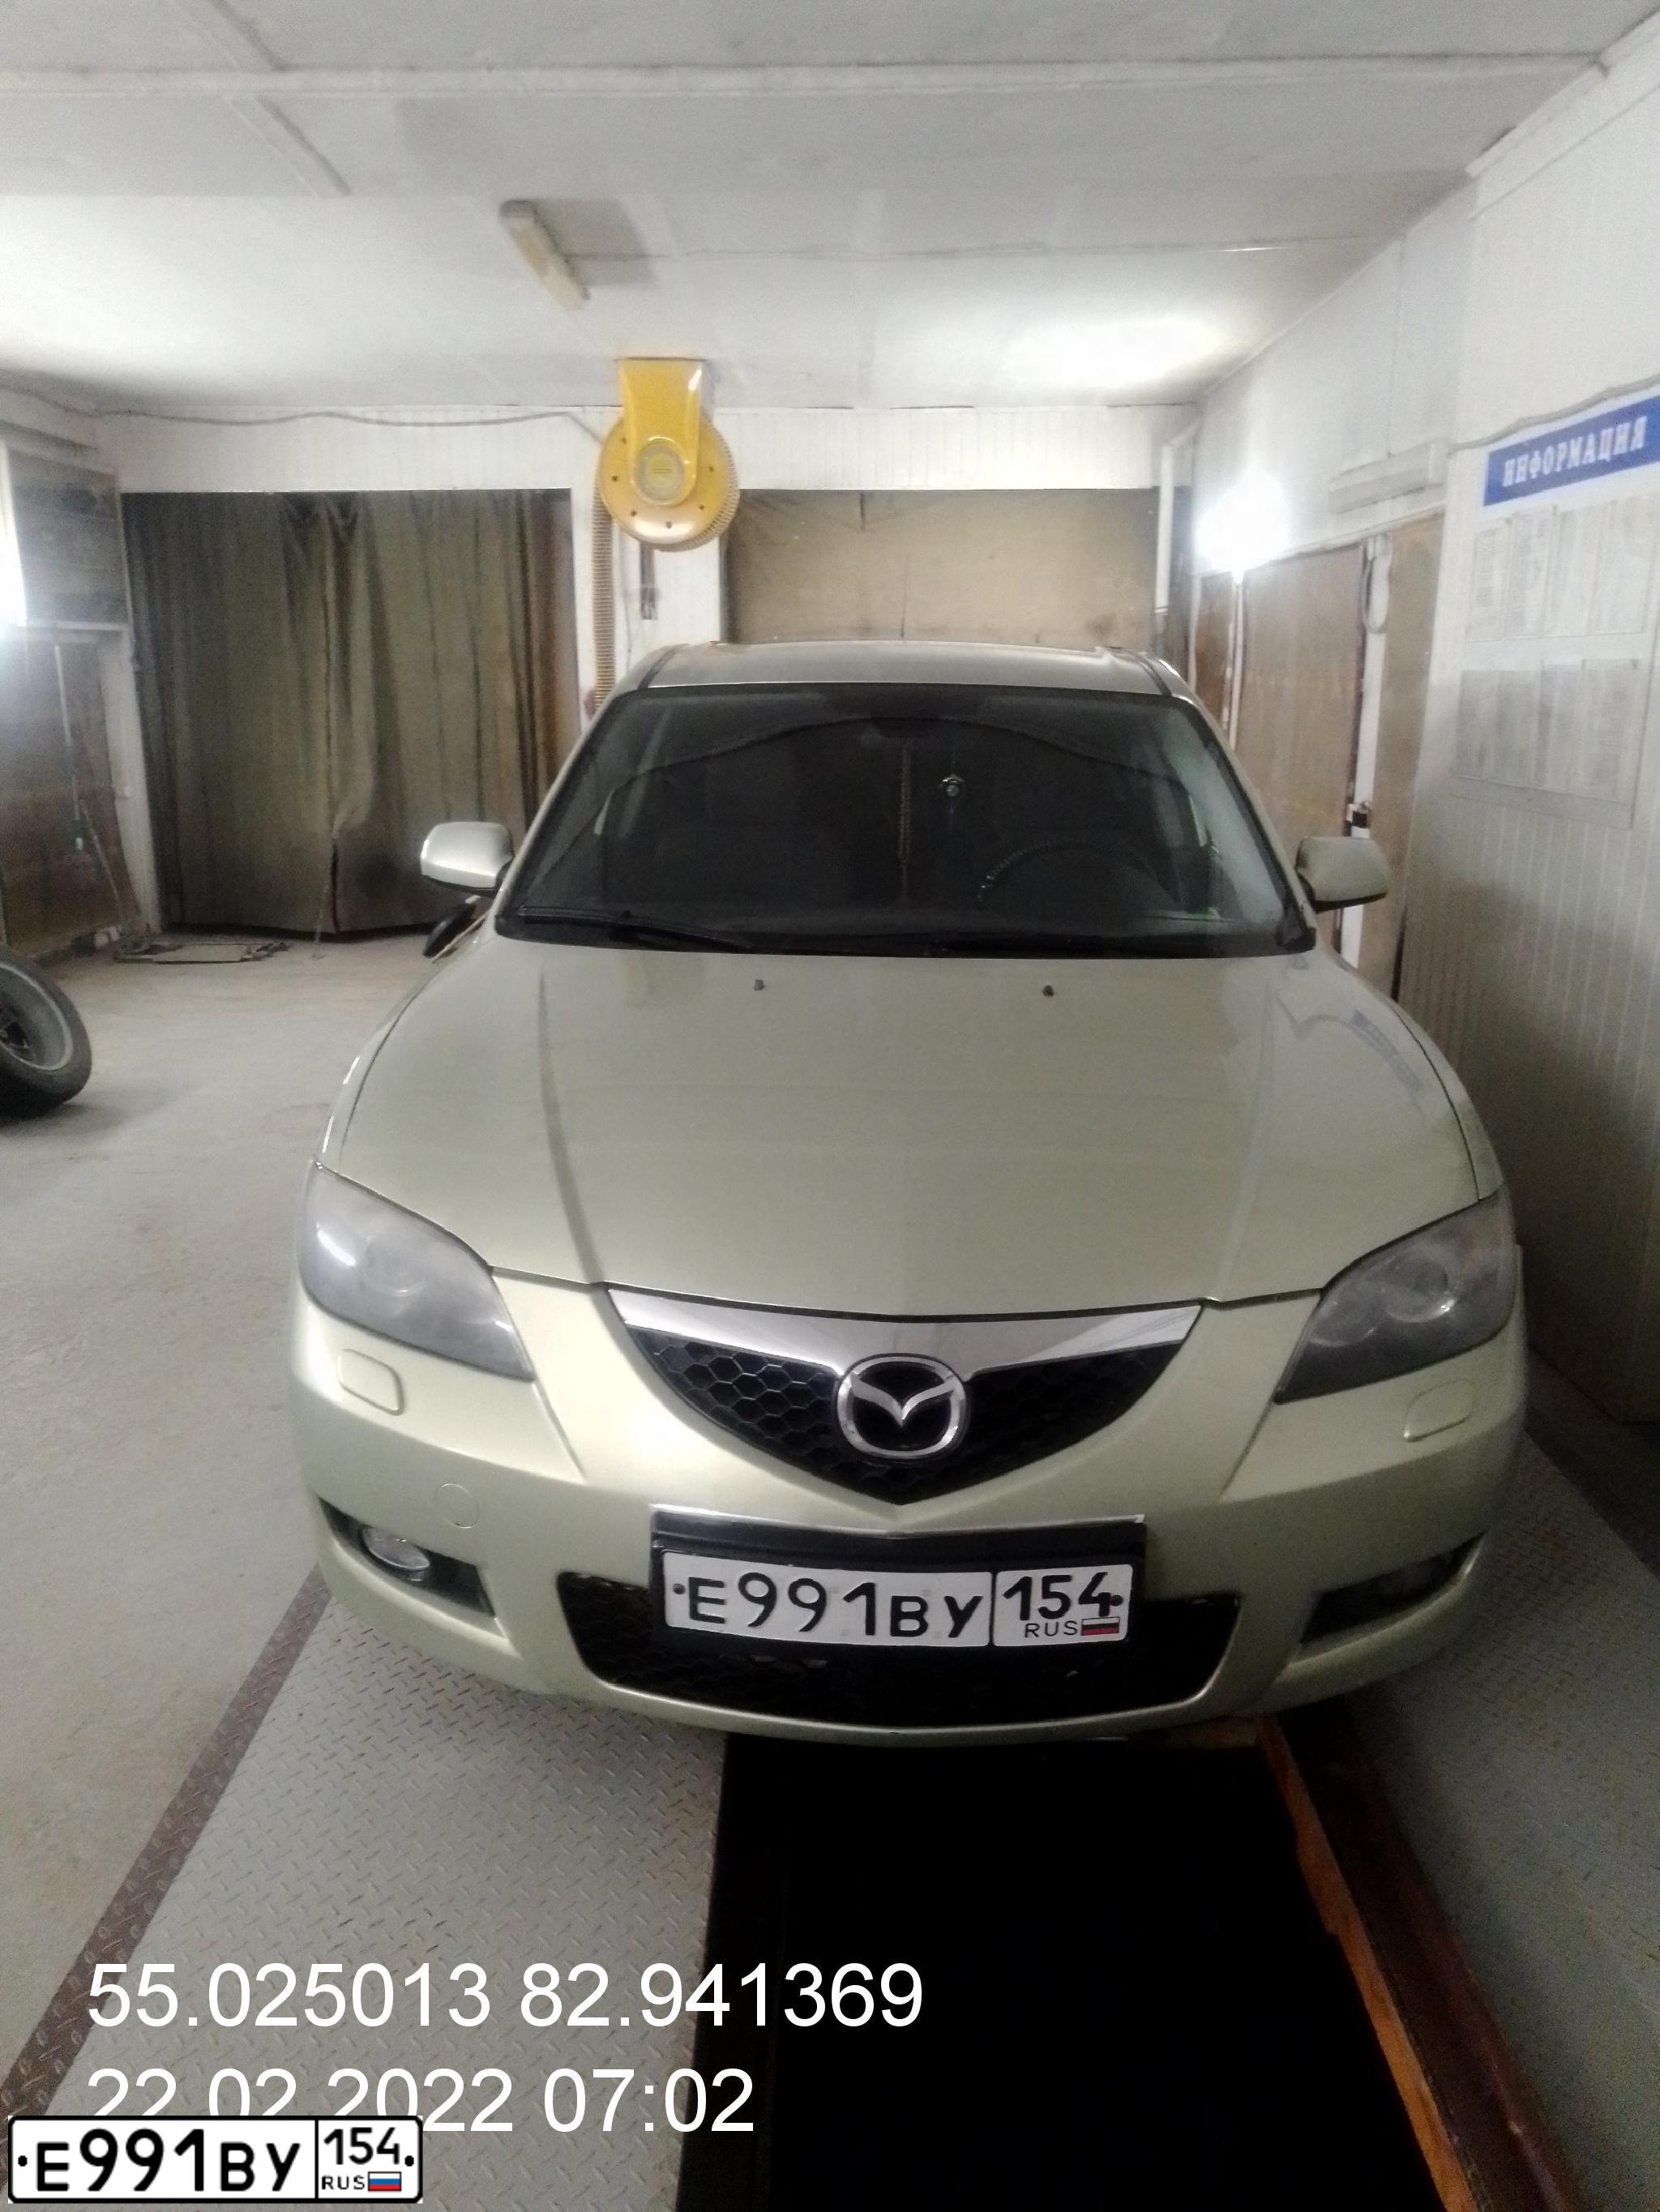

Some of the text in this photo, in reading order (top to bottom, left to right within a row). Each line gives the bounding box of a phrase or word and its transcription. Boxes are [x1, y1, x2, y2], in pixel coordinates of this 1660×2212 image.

[1502, 415, 1649, 487] ИНФОРМАЦИЯ
[688, 1571, 1117, 1638] Е991ВУ 154
[1024, 1619, 1079, 1638] RUS
